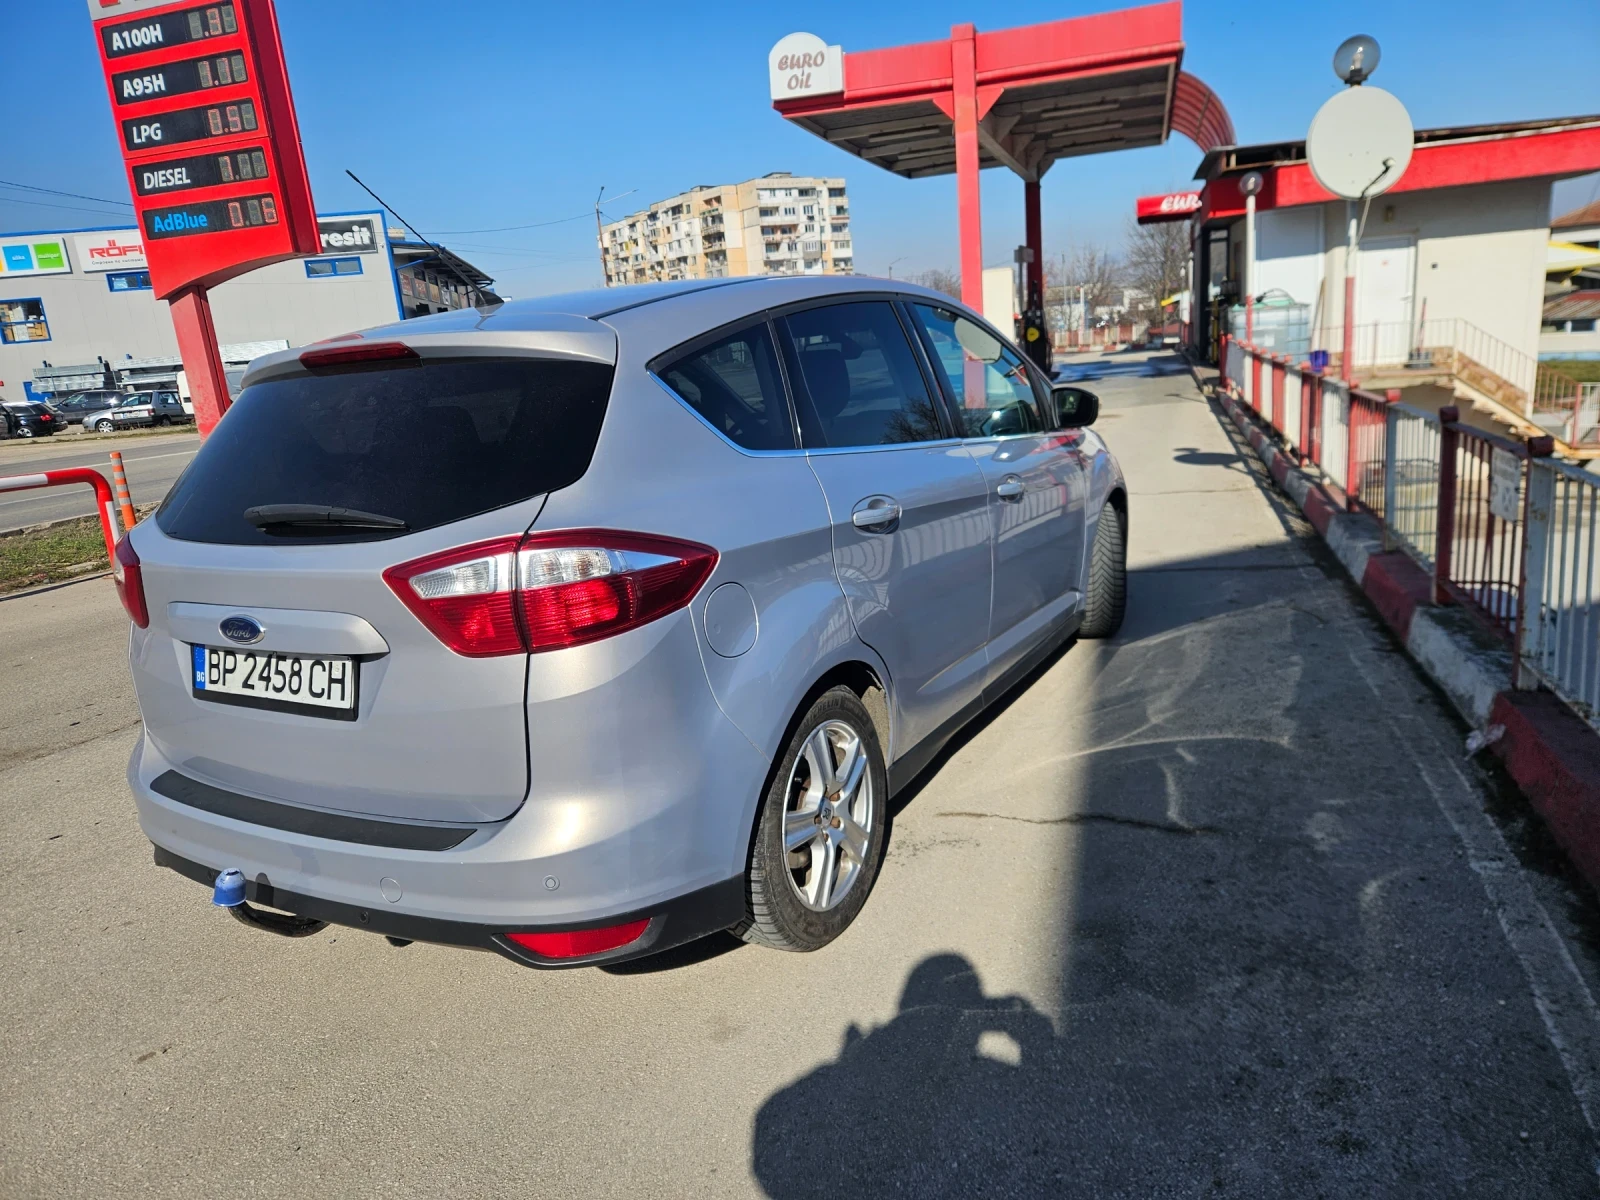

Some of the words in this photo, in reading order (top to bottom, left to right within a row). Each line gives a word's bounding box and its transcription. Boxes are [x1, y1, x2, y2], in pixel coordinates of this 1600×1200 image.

[112, 23, 163, 51] A100H
[123, 73, 166, 98] A95H
[132, 123, 162, 144] LPG
[143, 167, 191, 190] DIESEL
[154, 213, 208, 233] AdBlue
[88, 239, 145, 259] RÖFI
[225, 620, 251, 638] Ford
[196, 671, 205, 682] BG
[208, 649, 237, 687] BP
[242, 652, 303, 696] 2458
[308, 659, 346, 702] CH
